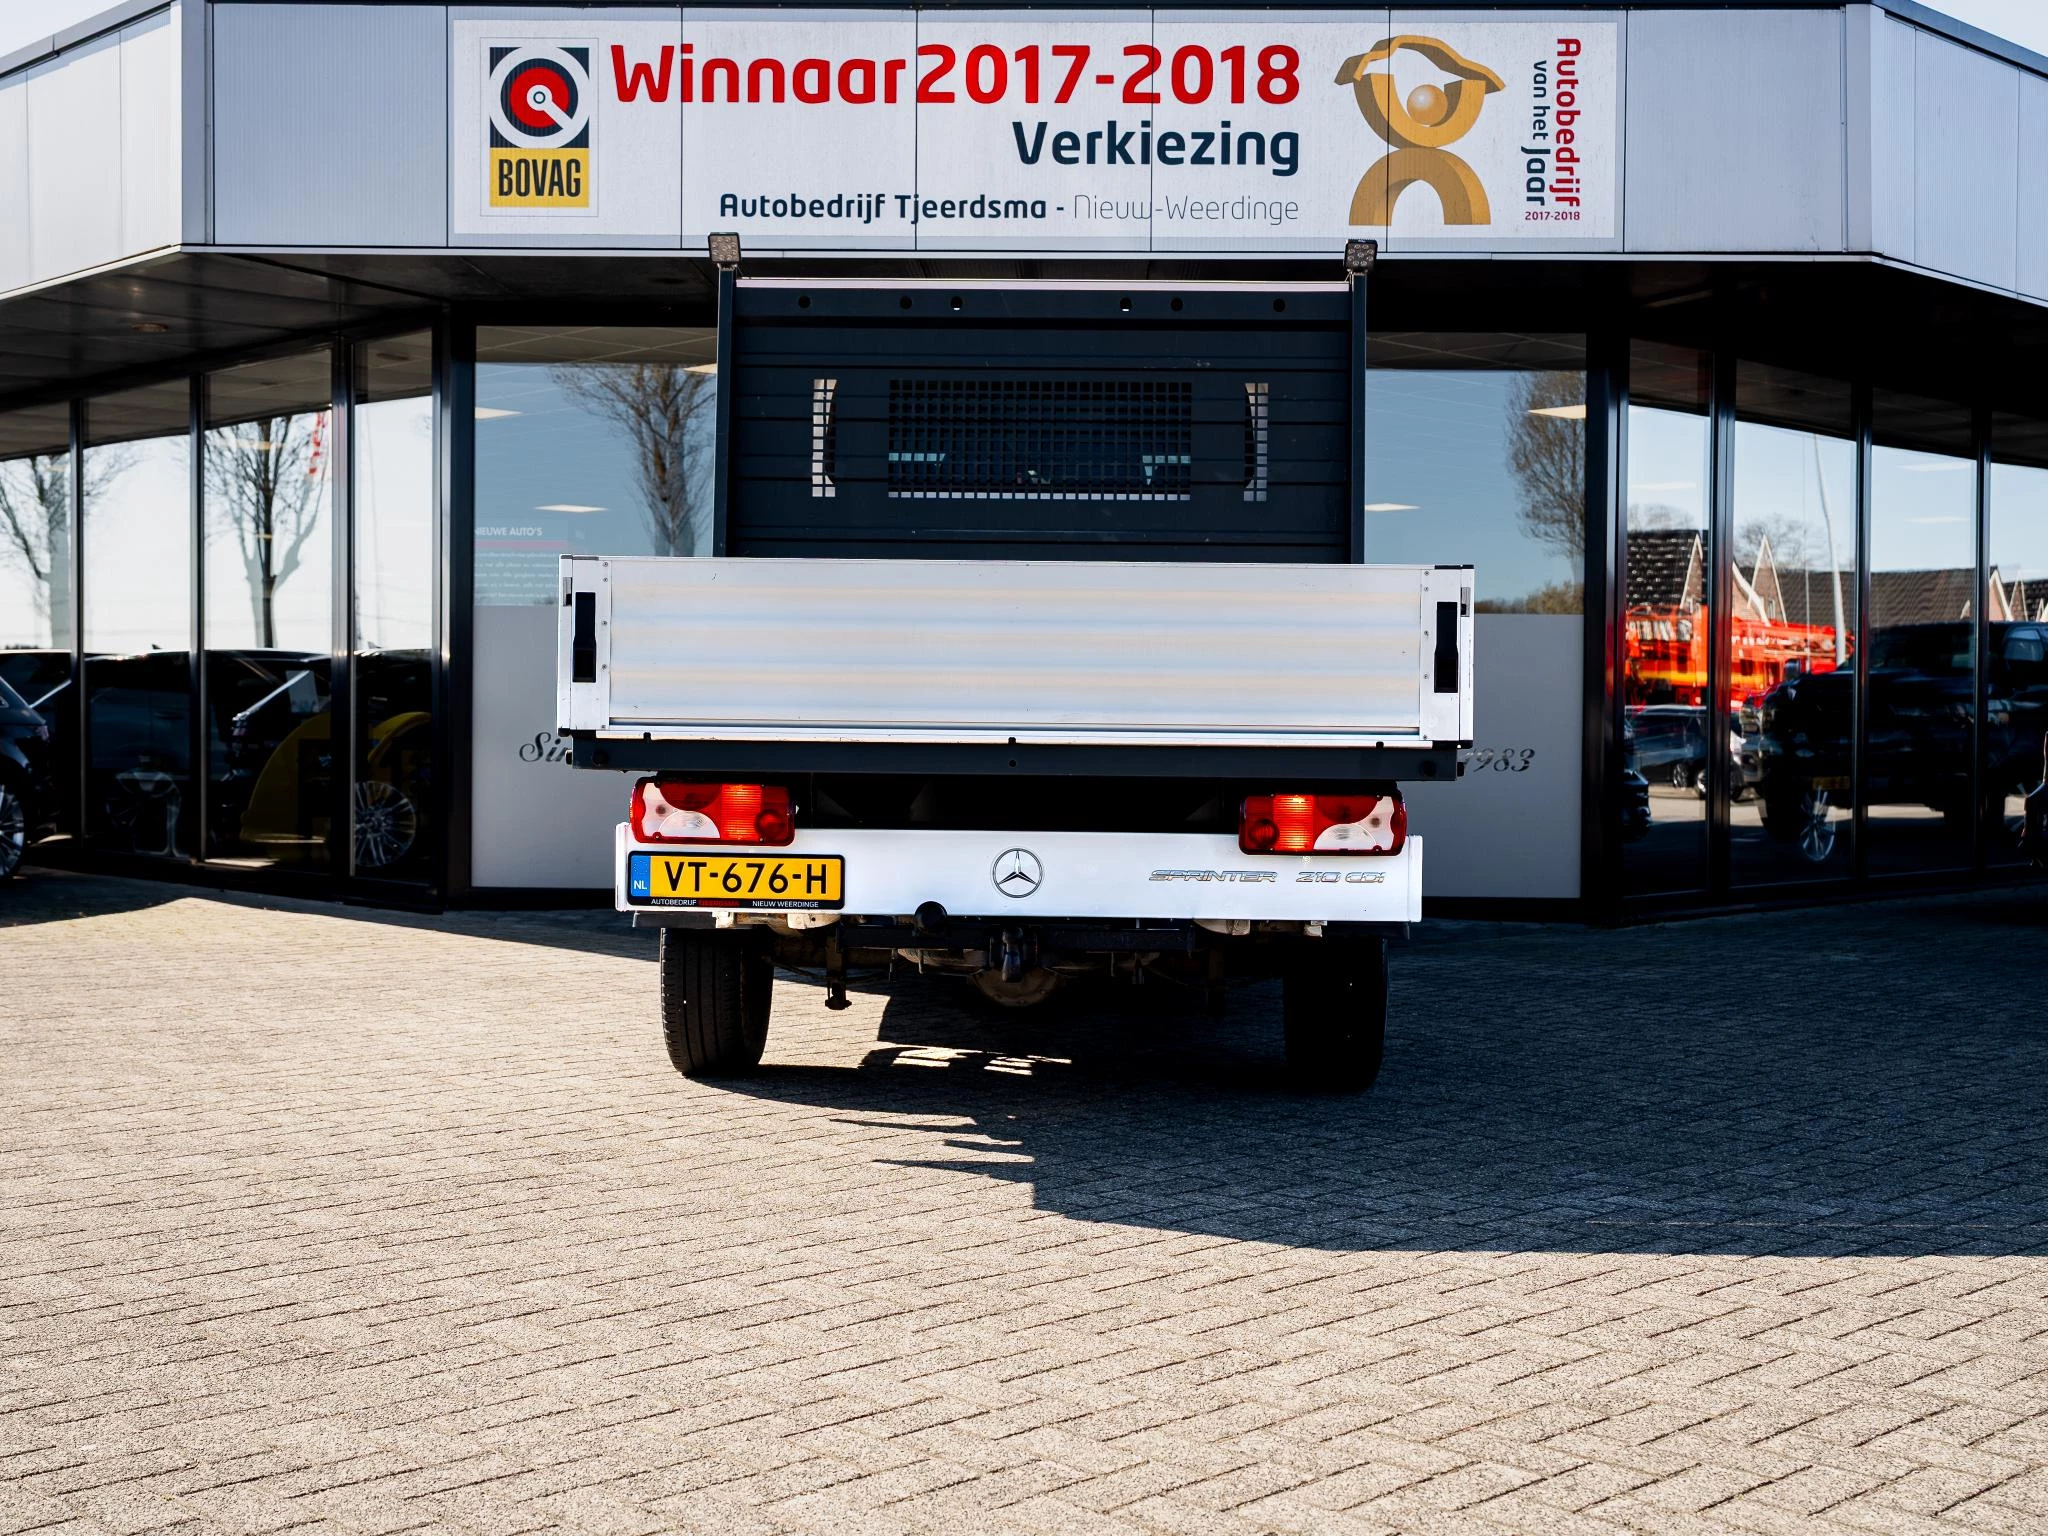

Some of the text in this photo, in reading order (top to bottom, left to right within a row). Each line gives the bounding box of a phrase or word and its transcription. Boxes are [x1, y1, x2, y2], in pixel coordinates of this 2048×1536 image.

[611, 43, 1300, 105] Winnaar 2017-2018
[1521, 60, 1551, 206] van het Jaar
[1549, 38, 1582, 207] Autobedrijf
[1012, 120, 1299, 177] Verkiezing
[498, 158, 581, 197] BOVAG
[720, 193, 887, 224] Autobedrijf
[895, 194, 1047, 224] Tjeerdsma
[1074, 194, 1299, 226] Nieuw-Weerdinge
[1525, 211, 1581, 221] 2017-2018
[633, 881, 647, 890] NL
[664, 861, 827, 894] VT-676-H
[1149, 869, 1278, 883] SPRINTER
[1296, 871, 1386, 883] 210 CDI
[651, 898, 697, 906] AUTOBEDRIJF
